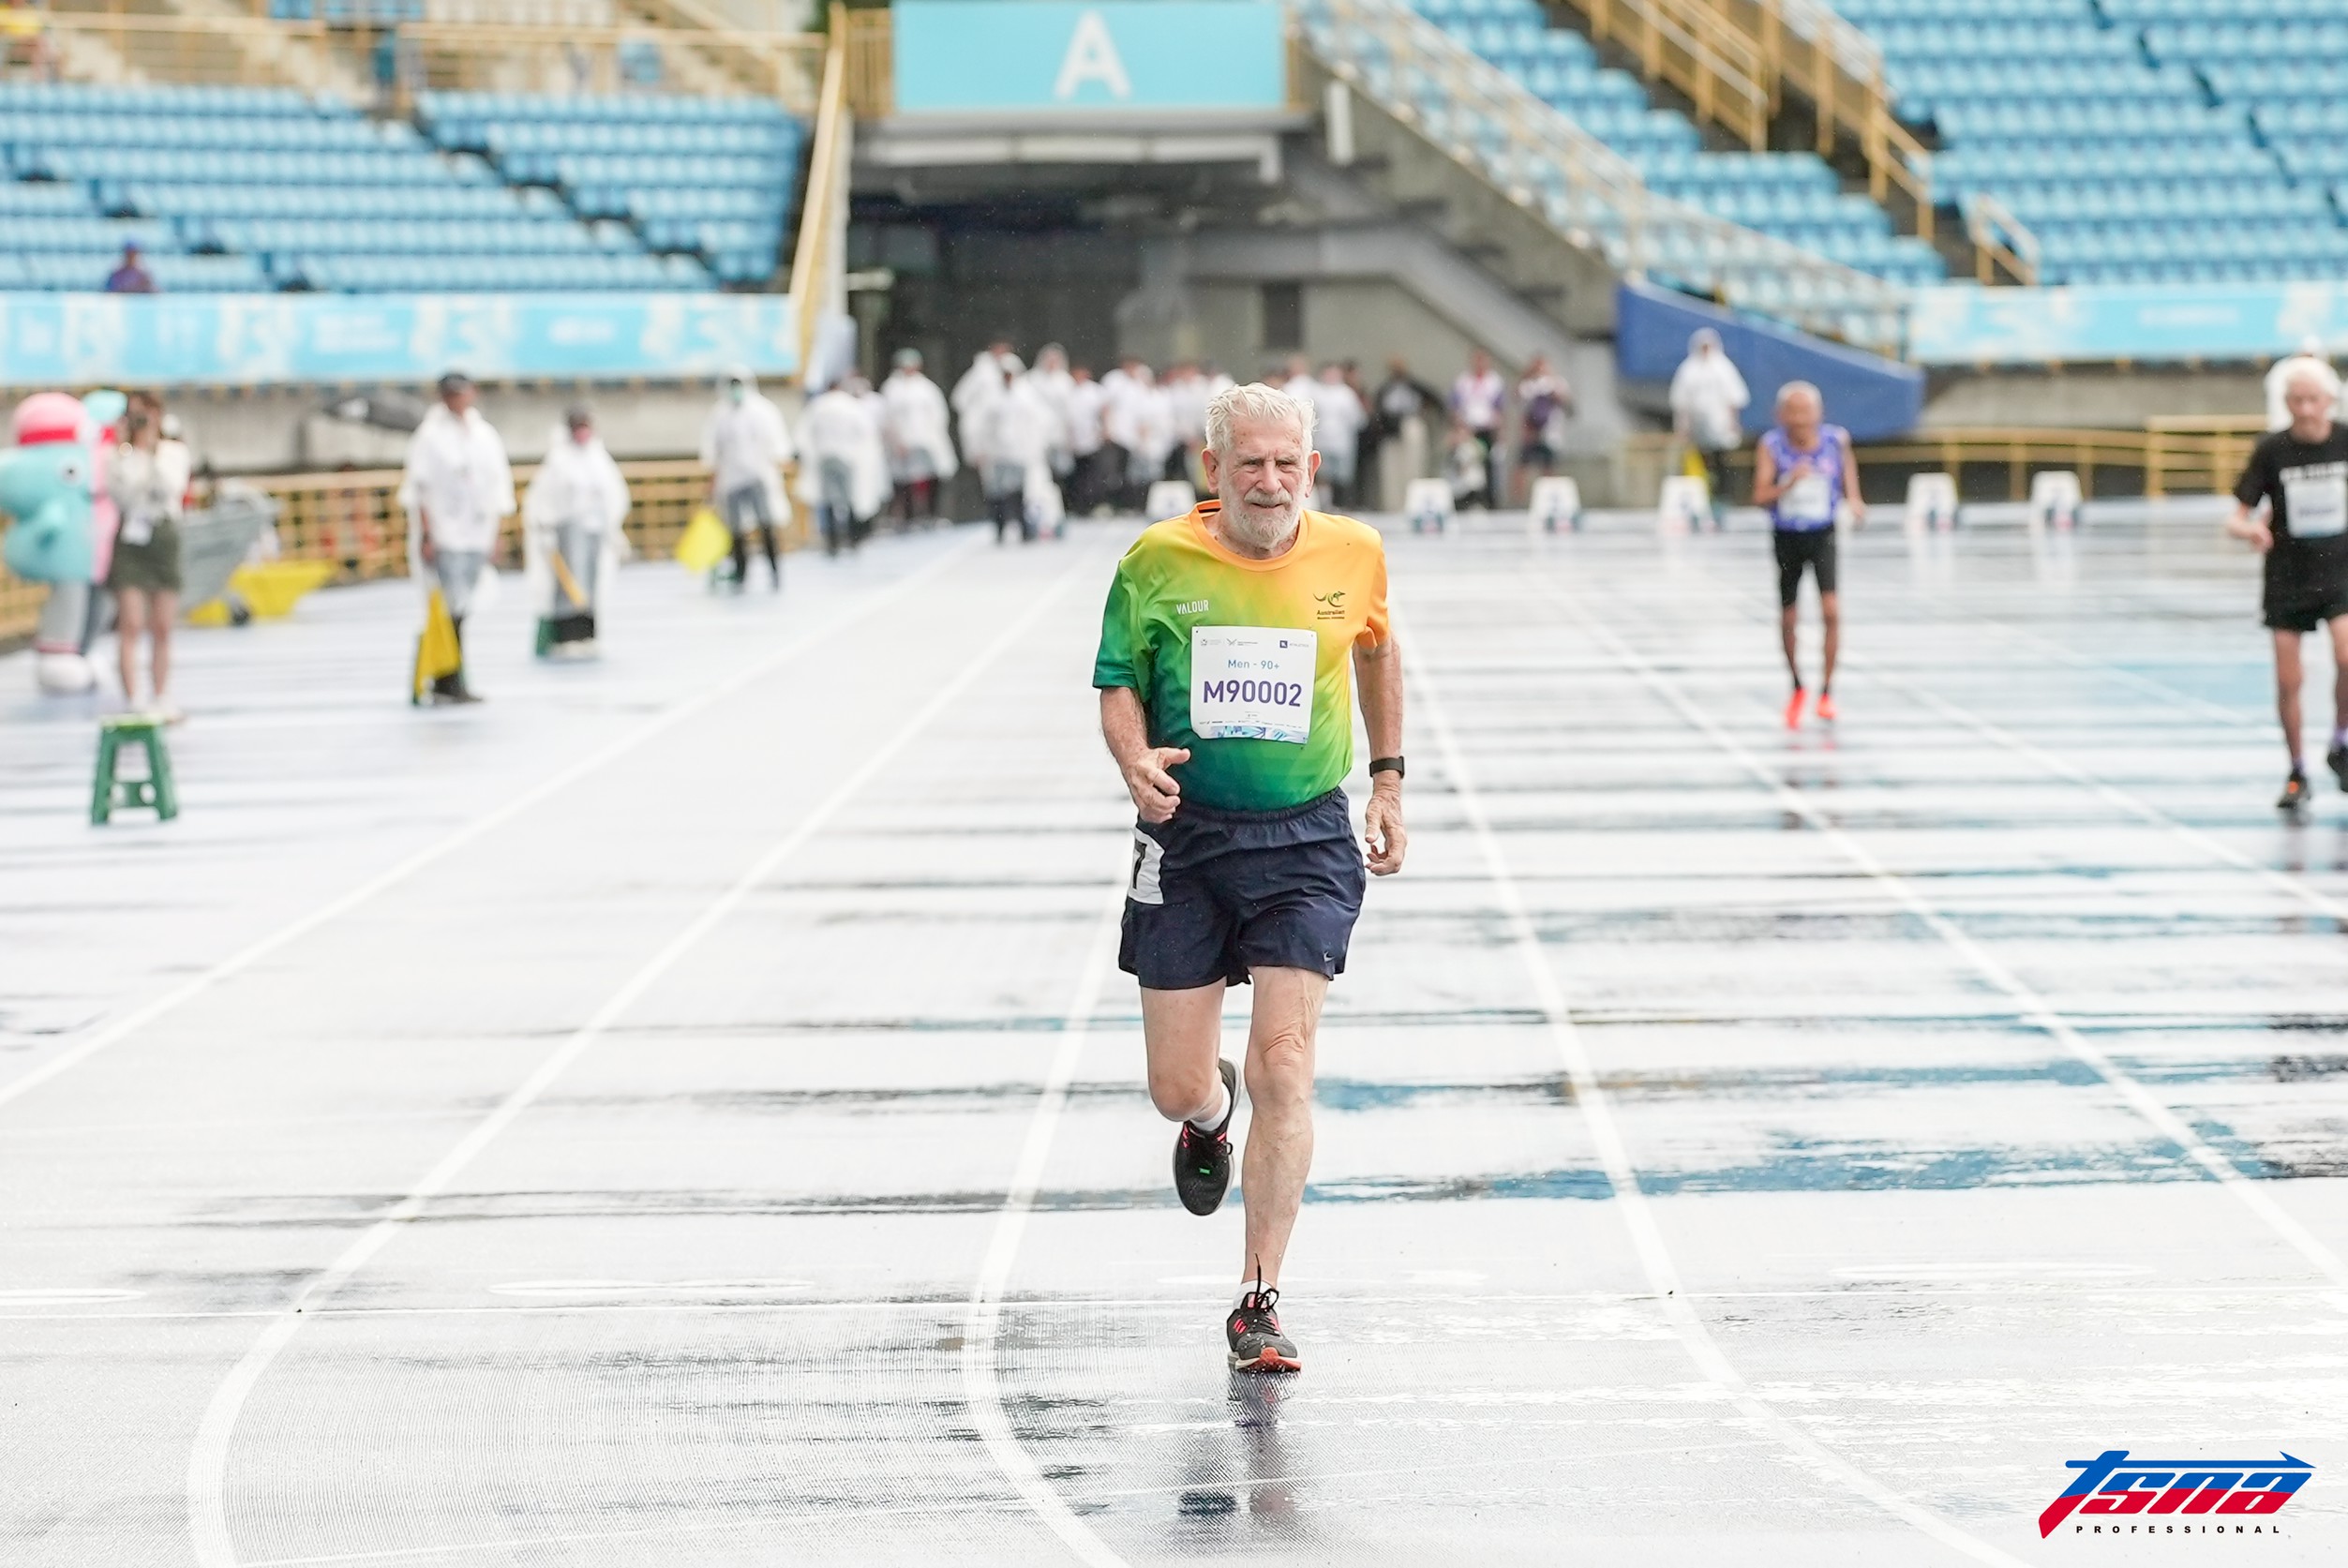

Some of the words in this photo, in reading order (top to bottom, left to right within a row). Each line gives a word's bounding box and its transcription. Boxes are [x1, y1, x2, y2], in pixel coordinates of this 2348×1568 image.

[1054, 9, 1131, 99] A
[1176, 600, 1208, 615] VALOUR
[1228, 660, 1249, 668] Men
[1261, 661, 1279, 669] 90+
[1204, 679, 1302, 707] M90002
